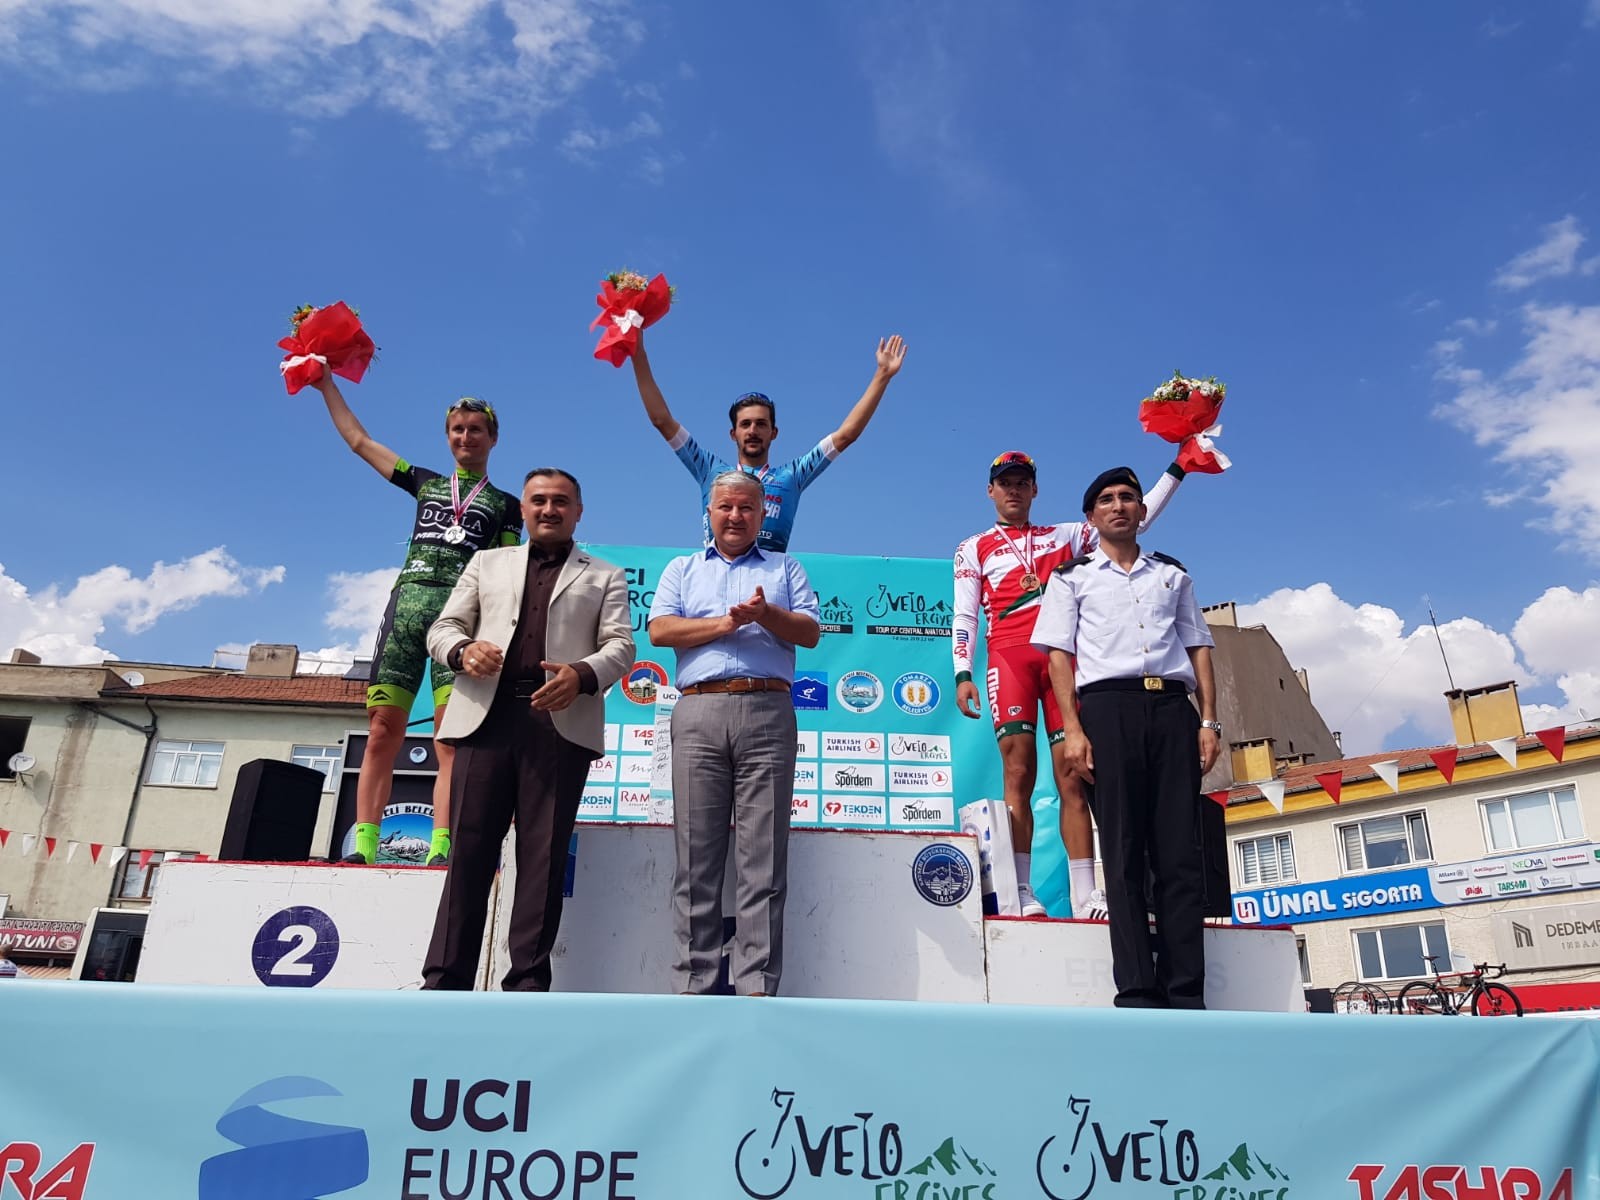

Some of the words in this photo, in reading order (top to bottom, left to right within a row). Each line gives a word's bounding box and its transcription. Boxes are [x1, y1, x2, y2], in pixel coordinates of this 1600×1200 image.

[421, 508, 483, 532] DUKLA
[994, 541, 1057, 557] BERUS
[624, 568, 646, 586] CI
[887, 591, 926, 613] VELO
[915, 612, 953, 627] ERCiYE
[875, 626, 890, 634] TOUR
[890, 626, 899, 634] OF
[899, 627, 924, 635] CENTRAL
[924, 628, 952, 636] ANATOLIA
[898, 674, 932, 686] TOMARZA
[904, 740, 928, 753] VELO
[893, 771, 928, 779] TURKISH
[893, 778, 929, 786] AIRLINES
[621, 790, 650, 802] RAM
[843, 803, 882, 814] TEKDEN
[1513, 858, 1544, 869] NEOVA
[1263, 889, 1337, 918] ÜNAL
[271, 924, 314, 976] 2
[410, 1078, 532, 1133] UCI
[794, 1112, 903, 1180] VELO
[1091, 1119, 1200, 1186] VELO
[0, 1141, 96, 1200] RA
[401, 1148, 639, 1200] EUROPE
[1347, 1164, 1575, 1200] TASHRA
